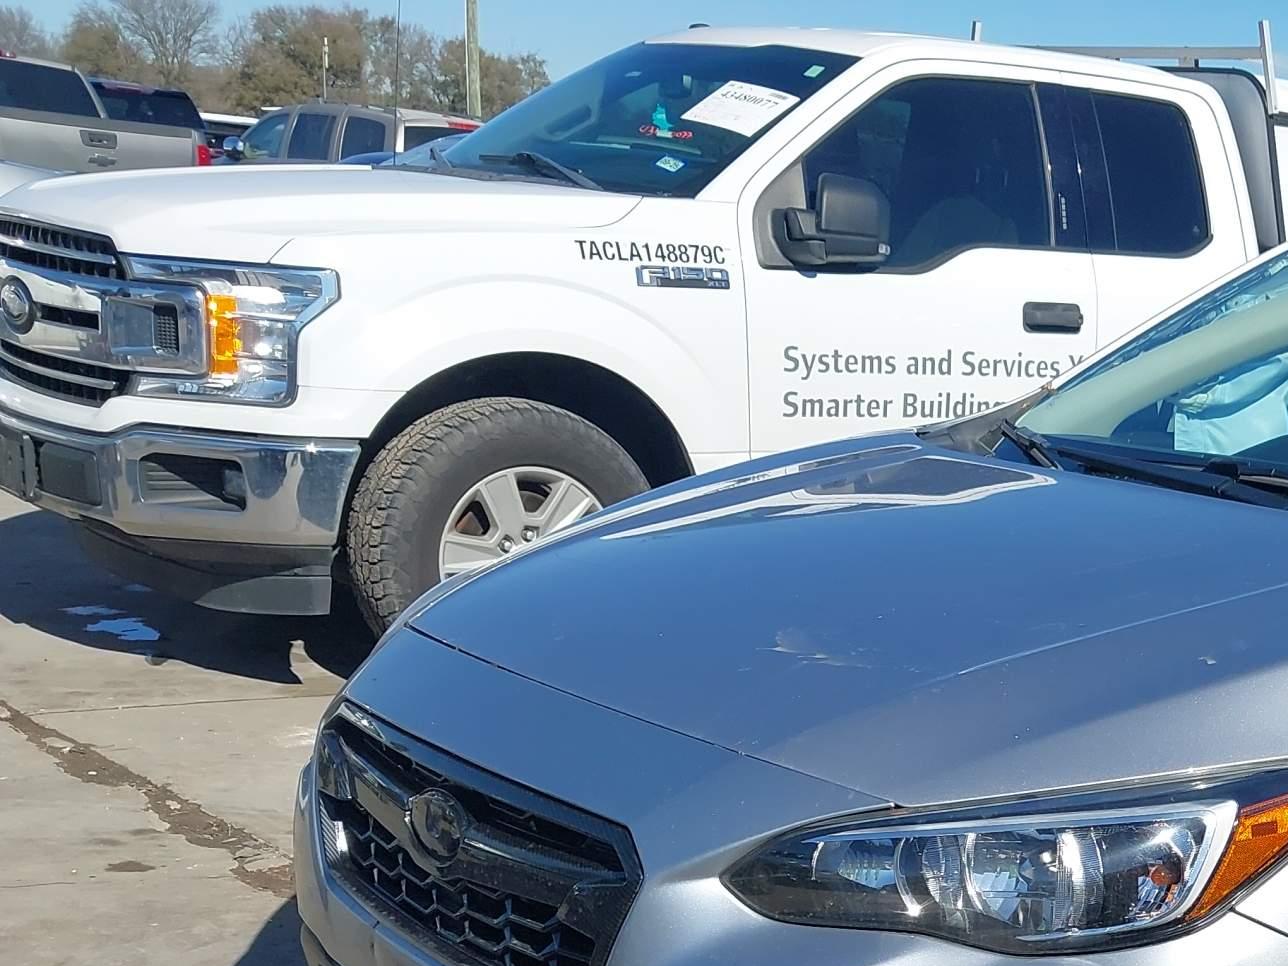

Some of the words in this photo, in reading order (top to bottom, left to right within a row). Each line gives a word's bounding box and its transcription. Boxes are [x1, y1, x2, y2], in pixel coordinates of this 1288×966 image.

[574, 240, 726, 264] TACLA148879C
[784, 346, 897, 380] Systems
[906, 349, 952, 376] and
[961, 351, 1060, 378] Services
[783, 391, 893, 418] Smarter
